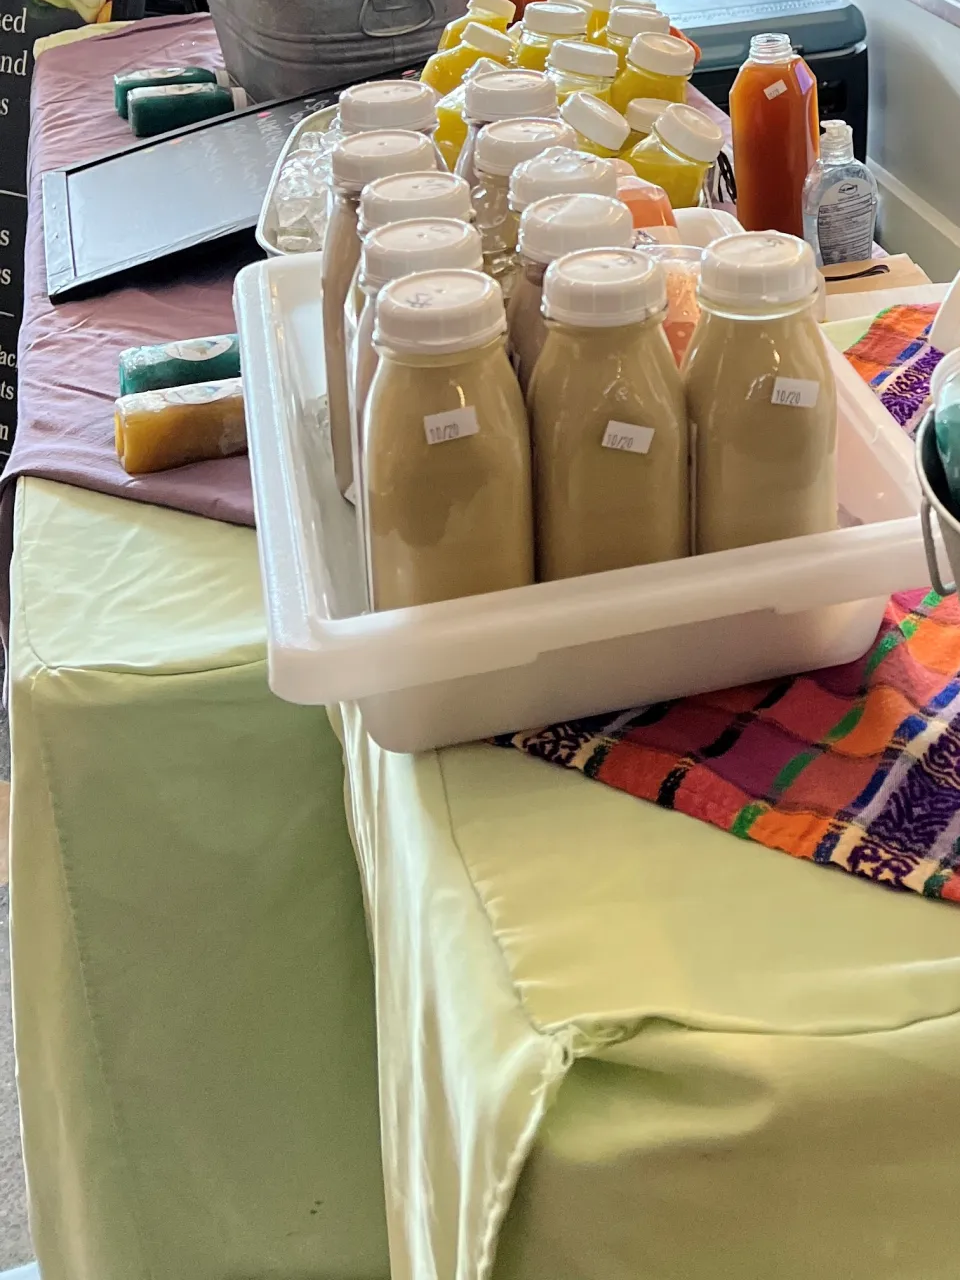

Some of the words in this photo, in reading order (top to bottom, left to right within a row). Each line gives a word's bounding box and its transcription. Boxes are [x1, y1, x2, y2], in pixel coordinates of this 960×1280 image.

[776, 389, 801, 404] 10/20
[430, 423, 460, 441] 10/20
[607, 433, 634, 449] 10/20
